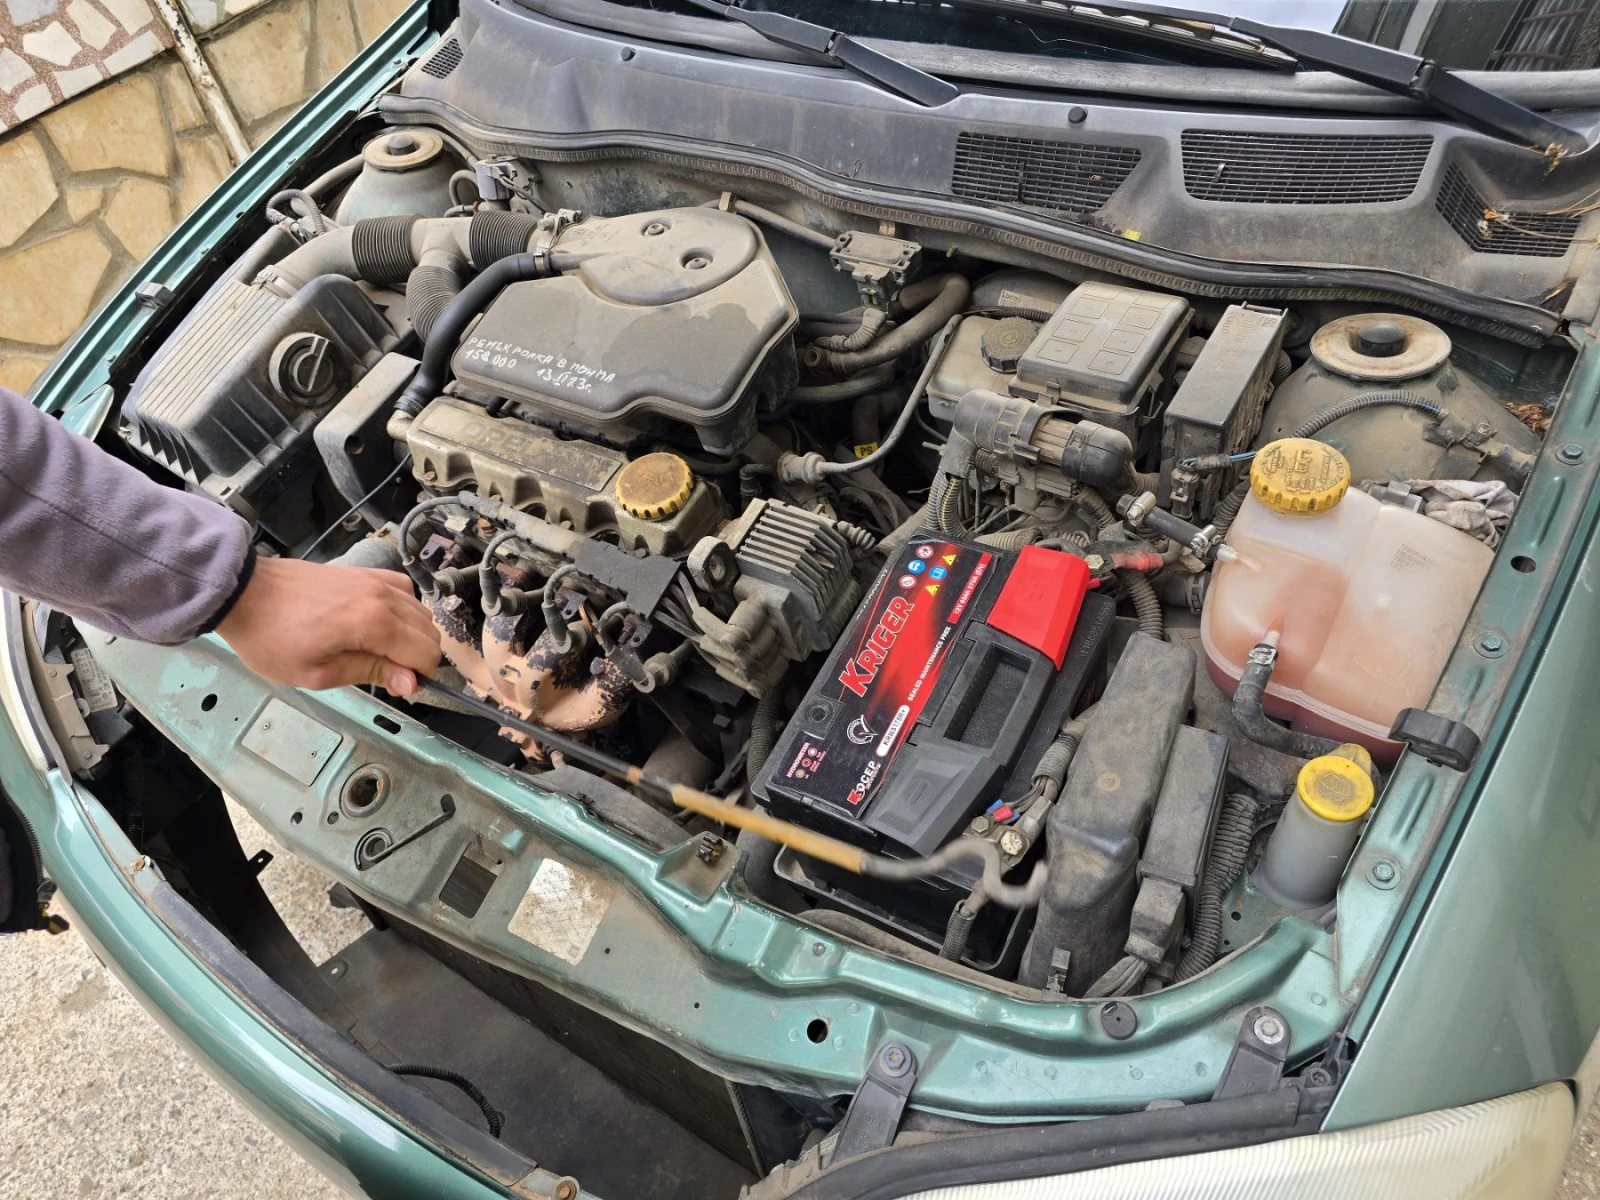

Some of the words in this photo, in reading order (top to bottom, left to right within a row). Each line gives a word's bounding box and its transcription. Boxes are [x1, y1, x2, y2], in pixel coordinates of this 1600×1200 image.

[860, 446, 874, 457] PS
[838, 596, 916, 698] KRIGER
[907, 679, 923, 702] SEALED
[920, 640, 945, 680] MAINTENANCE
[940, 625, 952, 641] FREE
